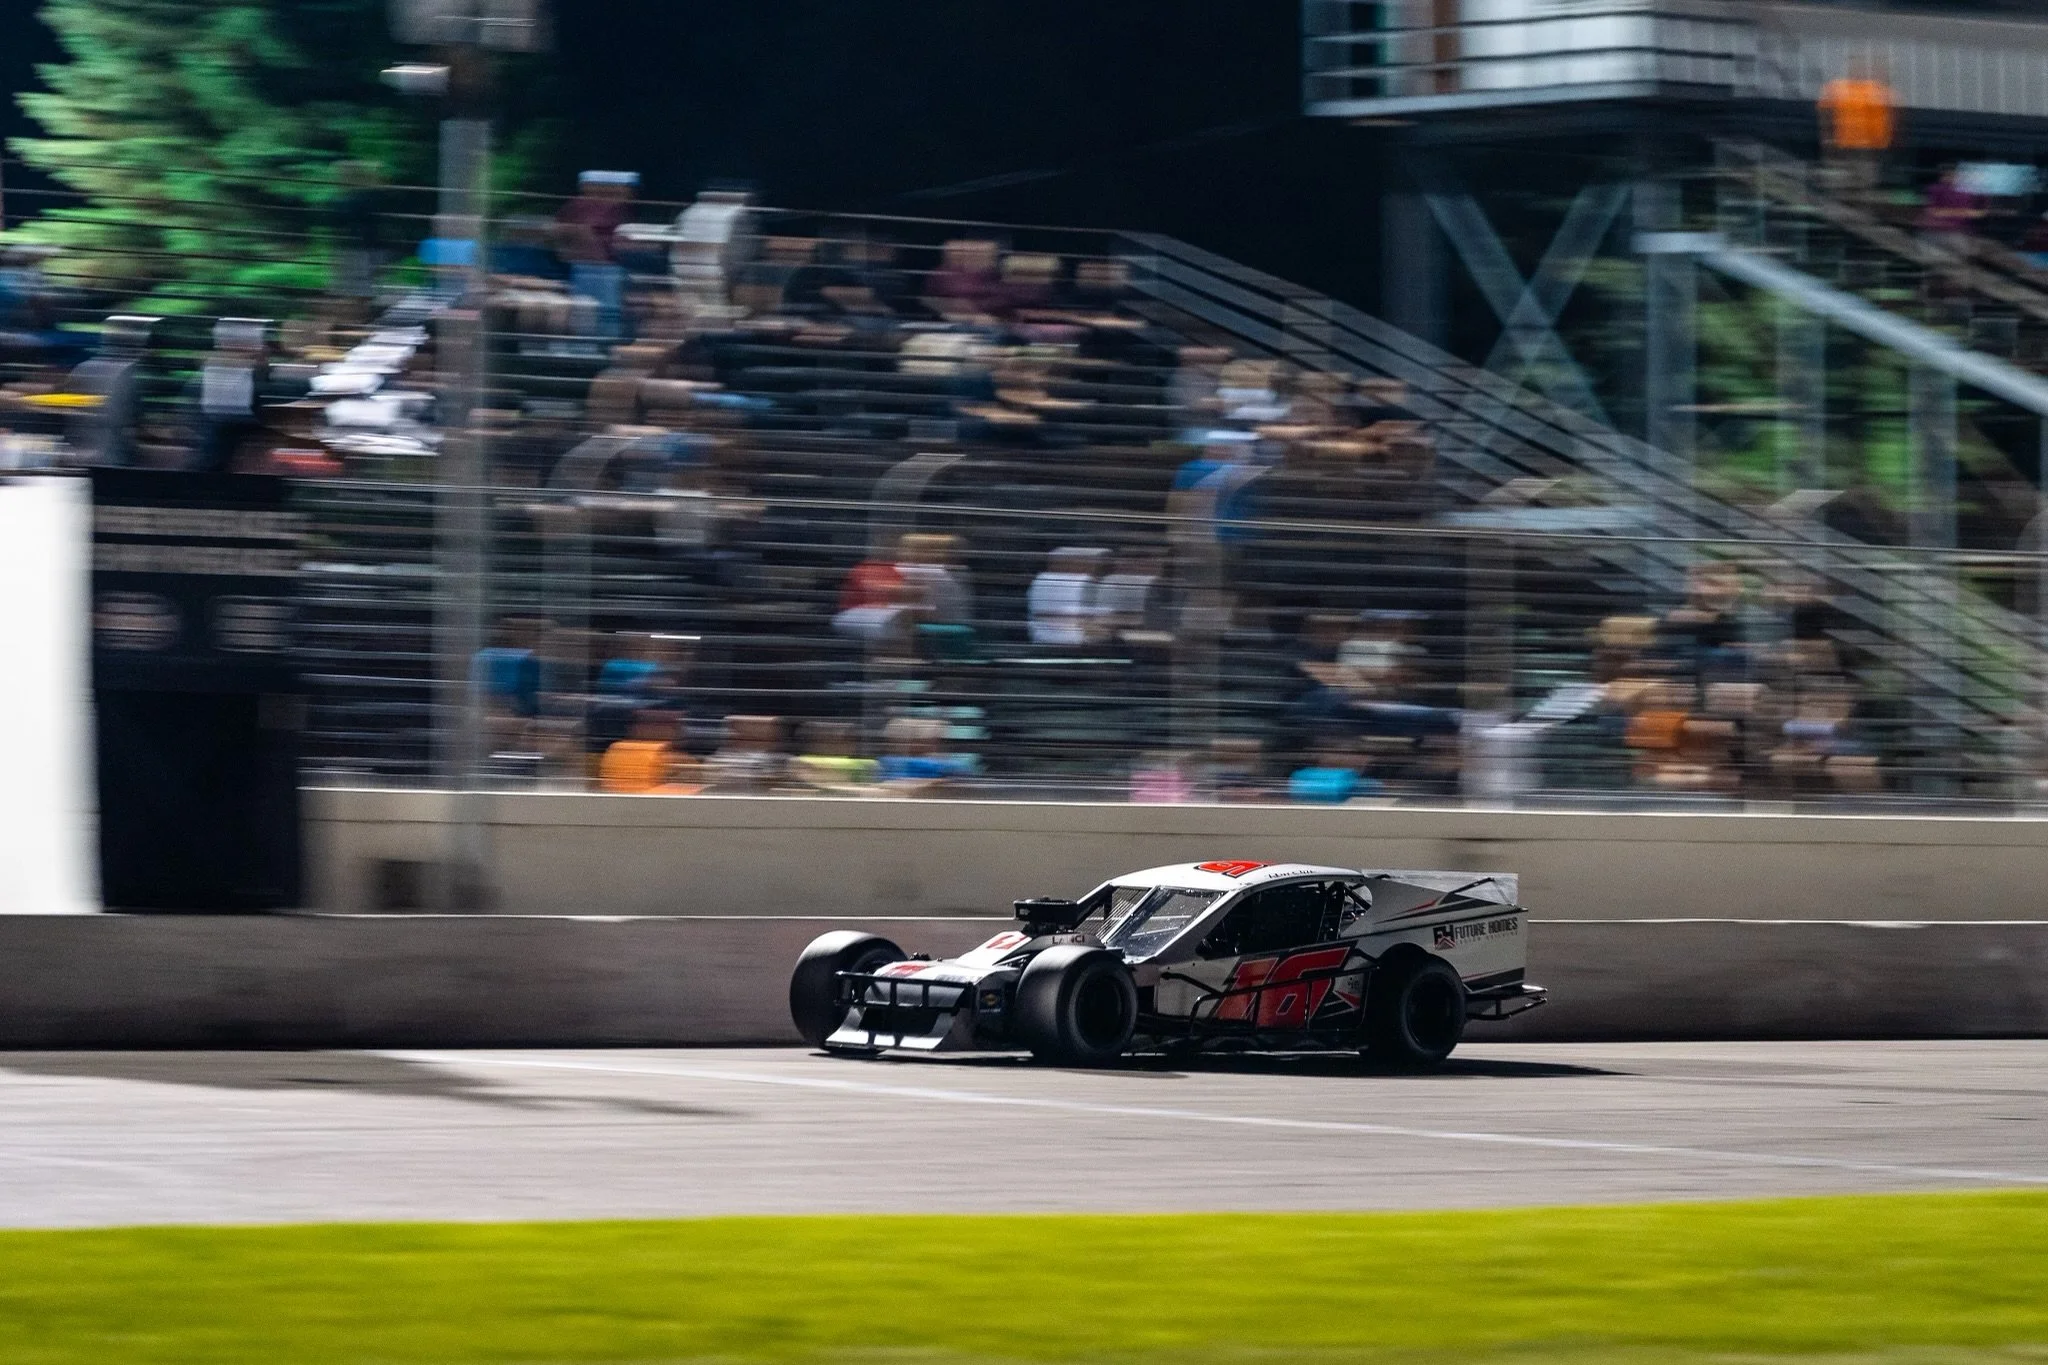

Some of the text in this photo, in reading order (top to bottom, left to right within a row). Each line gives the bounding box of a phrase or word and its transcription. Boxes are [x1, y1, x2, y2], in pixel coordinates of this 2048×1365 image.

[1455, 922, 1486, 939] FUTURE
[1488, 917, 1518, 934] HOMES
[1211, 946, 1351, 1028] 16
